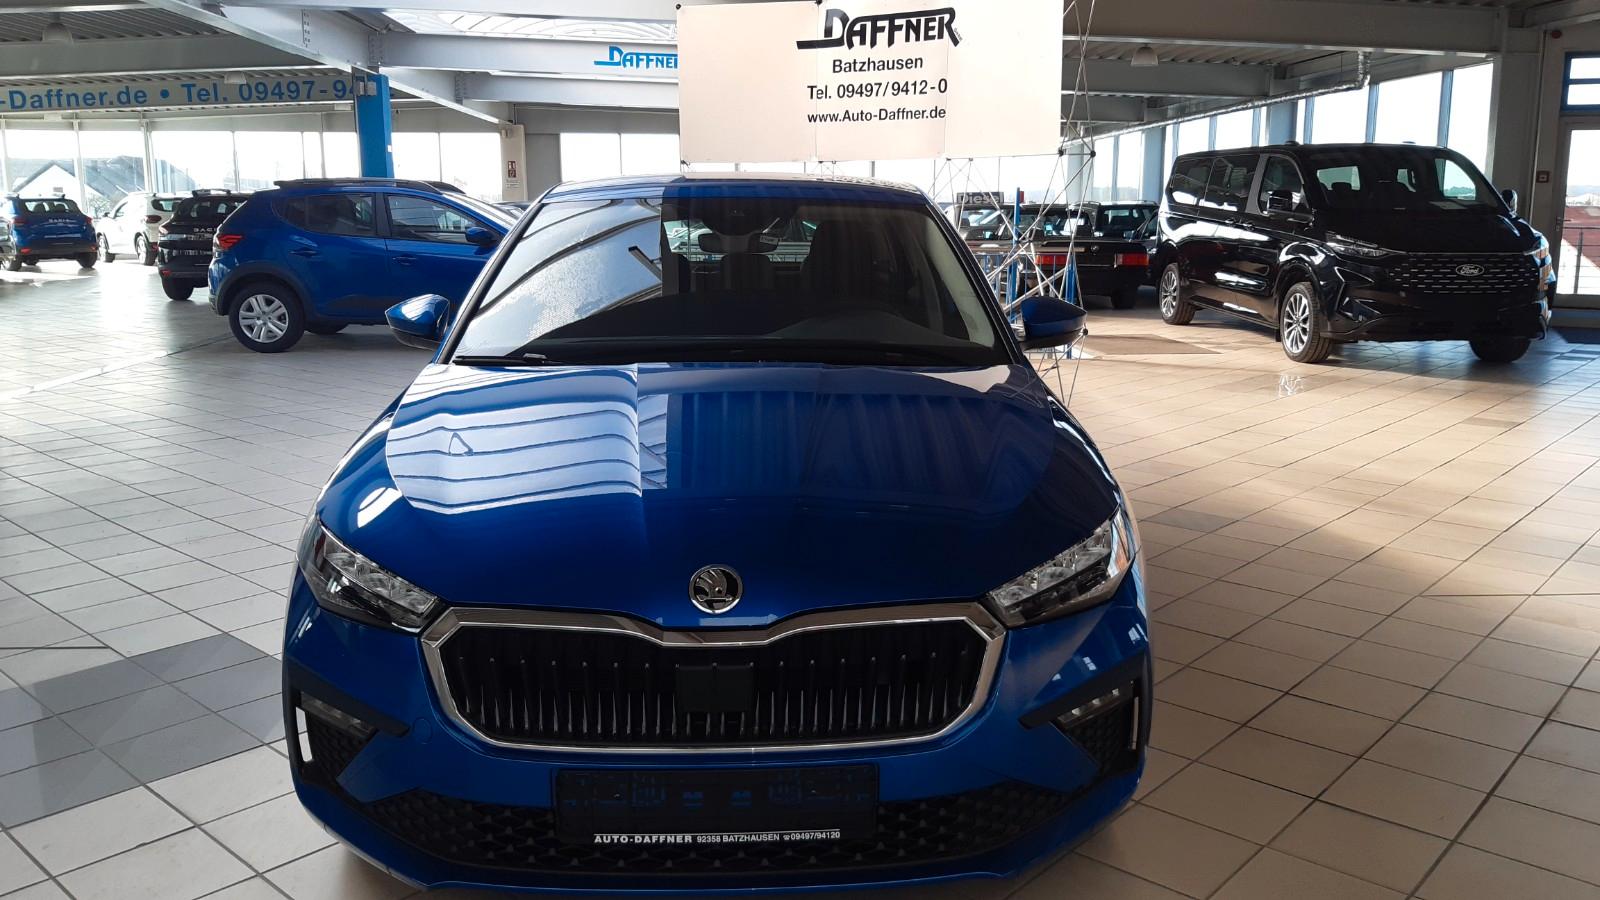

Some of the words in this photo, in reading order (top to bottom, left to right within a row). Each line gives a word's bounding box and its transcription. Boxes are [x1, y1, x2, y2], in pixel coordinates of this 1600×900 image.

[796, 7, 960, 50] DAFFNER
[832, 57, 923, 74] Batzhausen
[181, 82, 228, 103] Tel.
[239, 79, 354, 101] 09497-9
[807, 84, 832, 100] Tel.
[836, 78, 948, 99] 09497/9412-0
[807, 106, 947, 123] www.Auto-Daffner.de
[957, 192, 1004, 205] Diesel
[1459, 264, 1481, 275] Ford
[594, 835, 692, 844] AUTO-DAFFNER
[696, 834, 721, 843] 92358
[722, 833, 780, 842] BATZHAUSEN
[790, 831, 840, 841] 09497/94120
